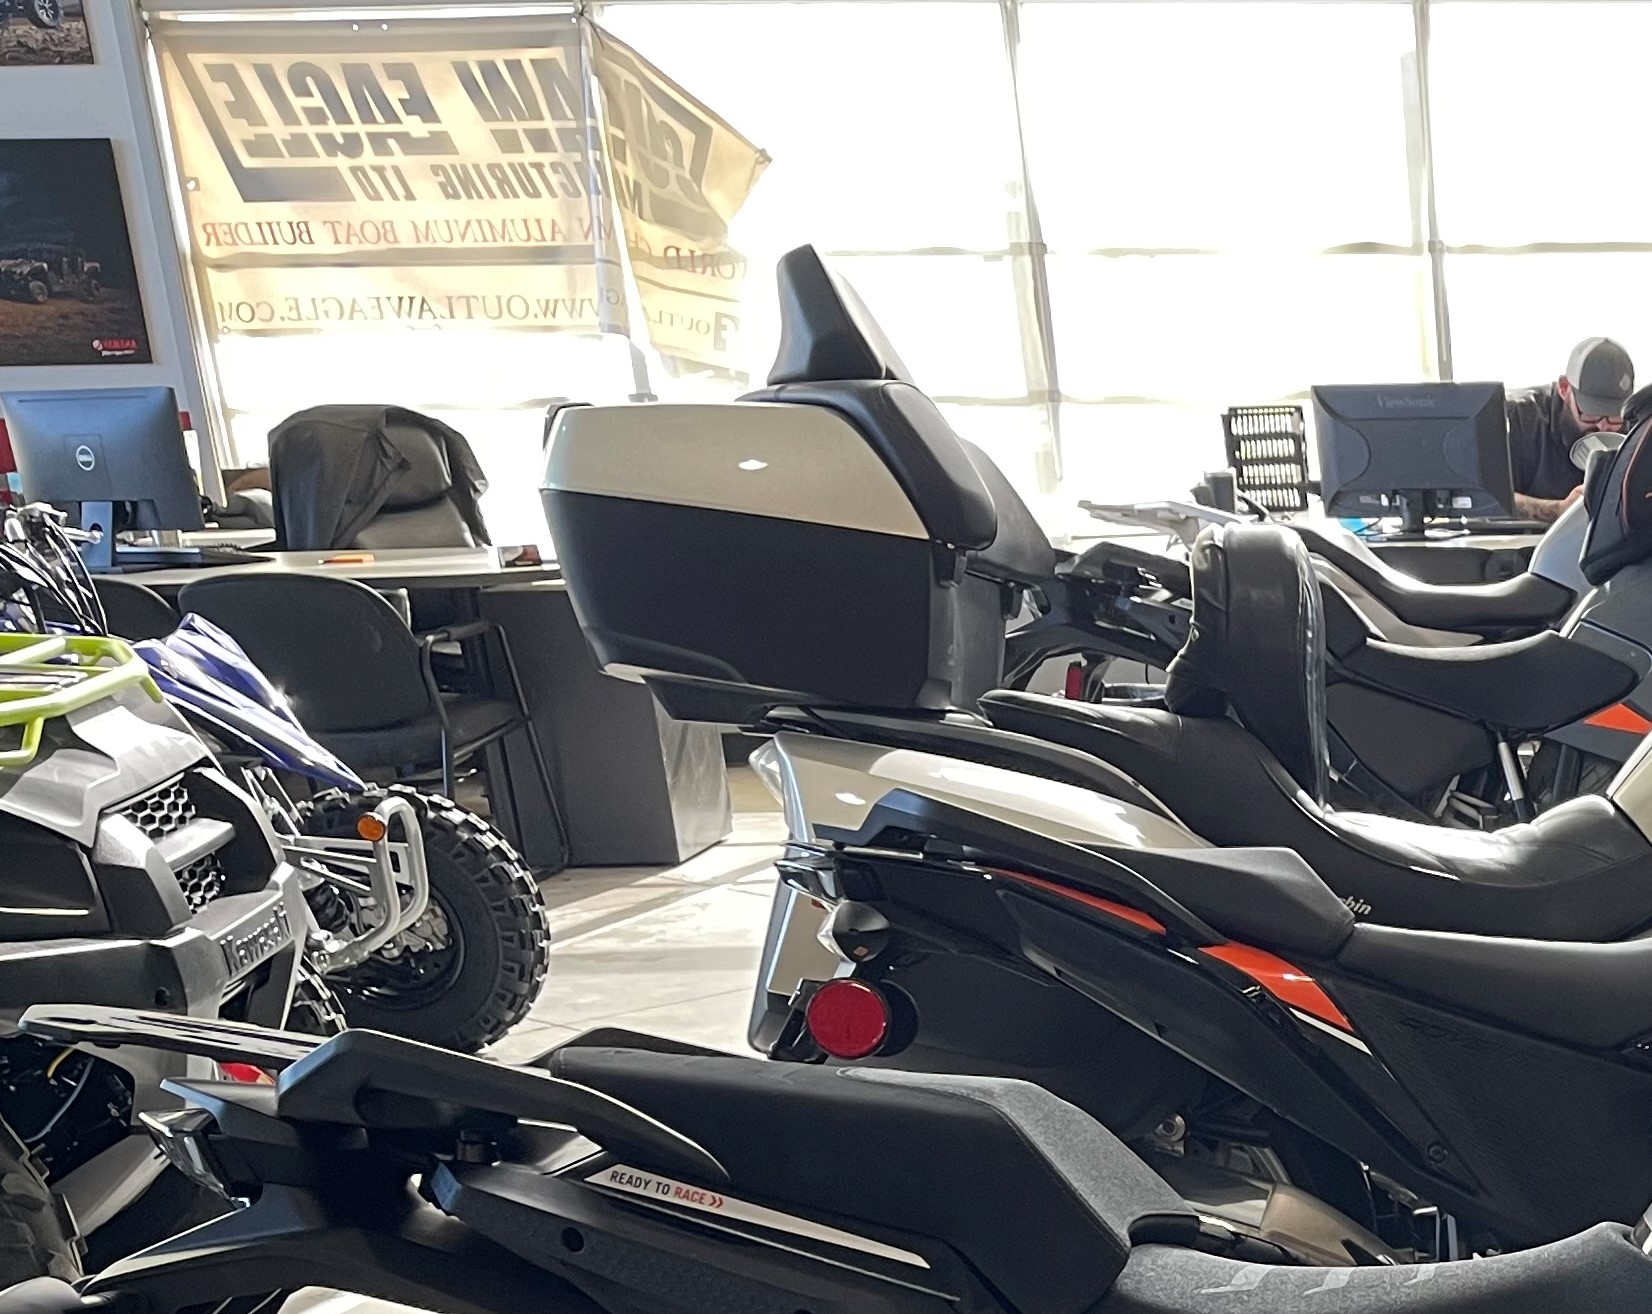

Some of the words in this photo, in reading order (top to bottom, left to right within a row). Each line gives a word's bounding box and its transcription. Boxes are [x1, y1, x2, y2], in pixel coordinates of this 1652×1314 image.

[609, 1170, 653, 1190] READY
[655, 1181, 671, 1196] TO
[673, 1186, 708, 1206] RACE
